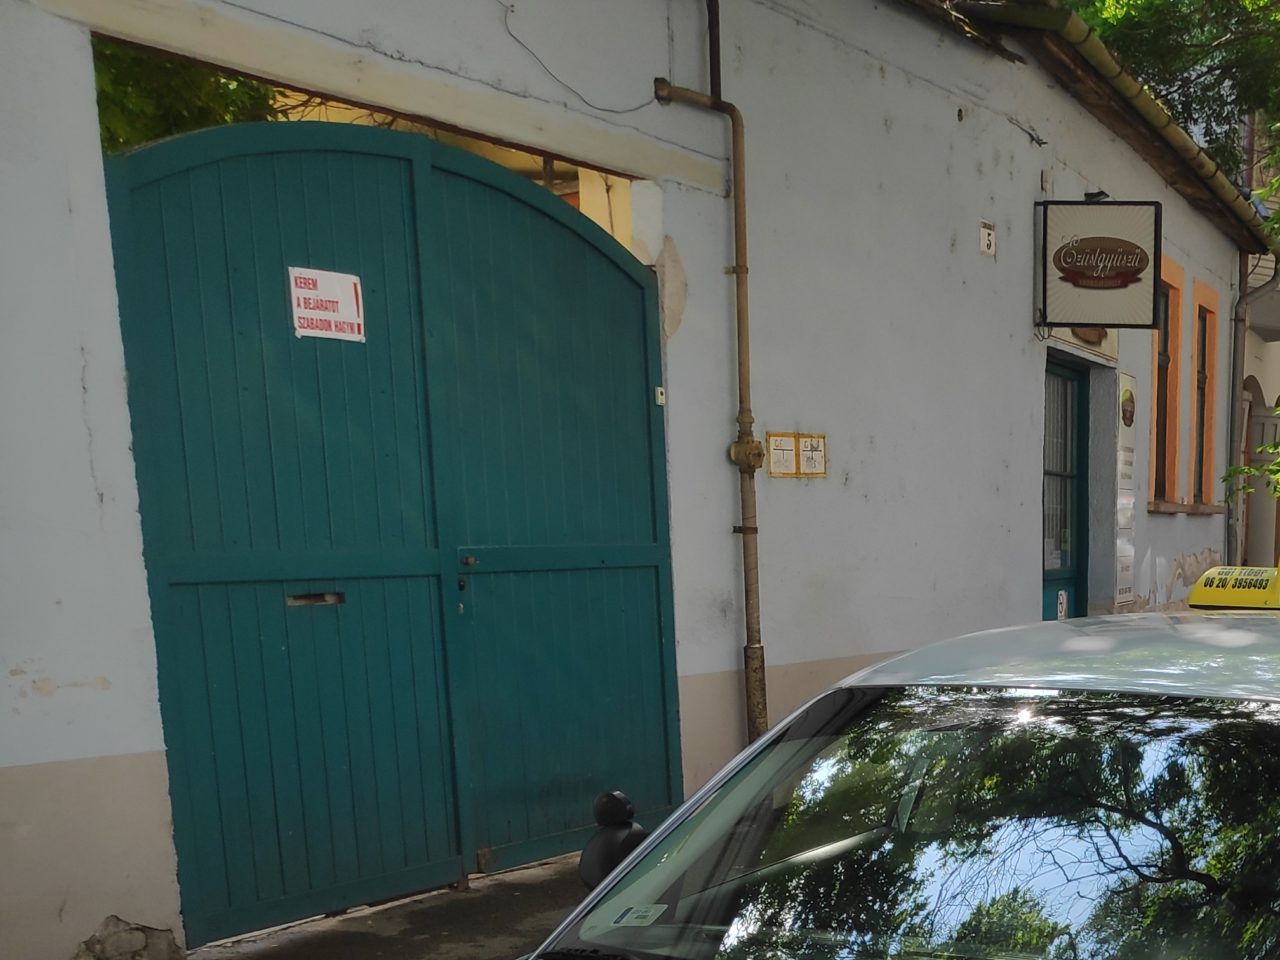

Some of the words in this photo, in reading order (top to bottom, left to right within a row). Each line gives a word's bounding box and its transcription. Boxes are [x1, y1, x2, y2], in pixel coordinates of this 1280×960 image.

[986, 231, 992, 250] 5
[1203, 576, 1215, 588] 06
[1231, 578, 1270, 590] 3956493
